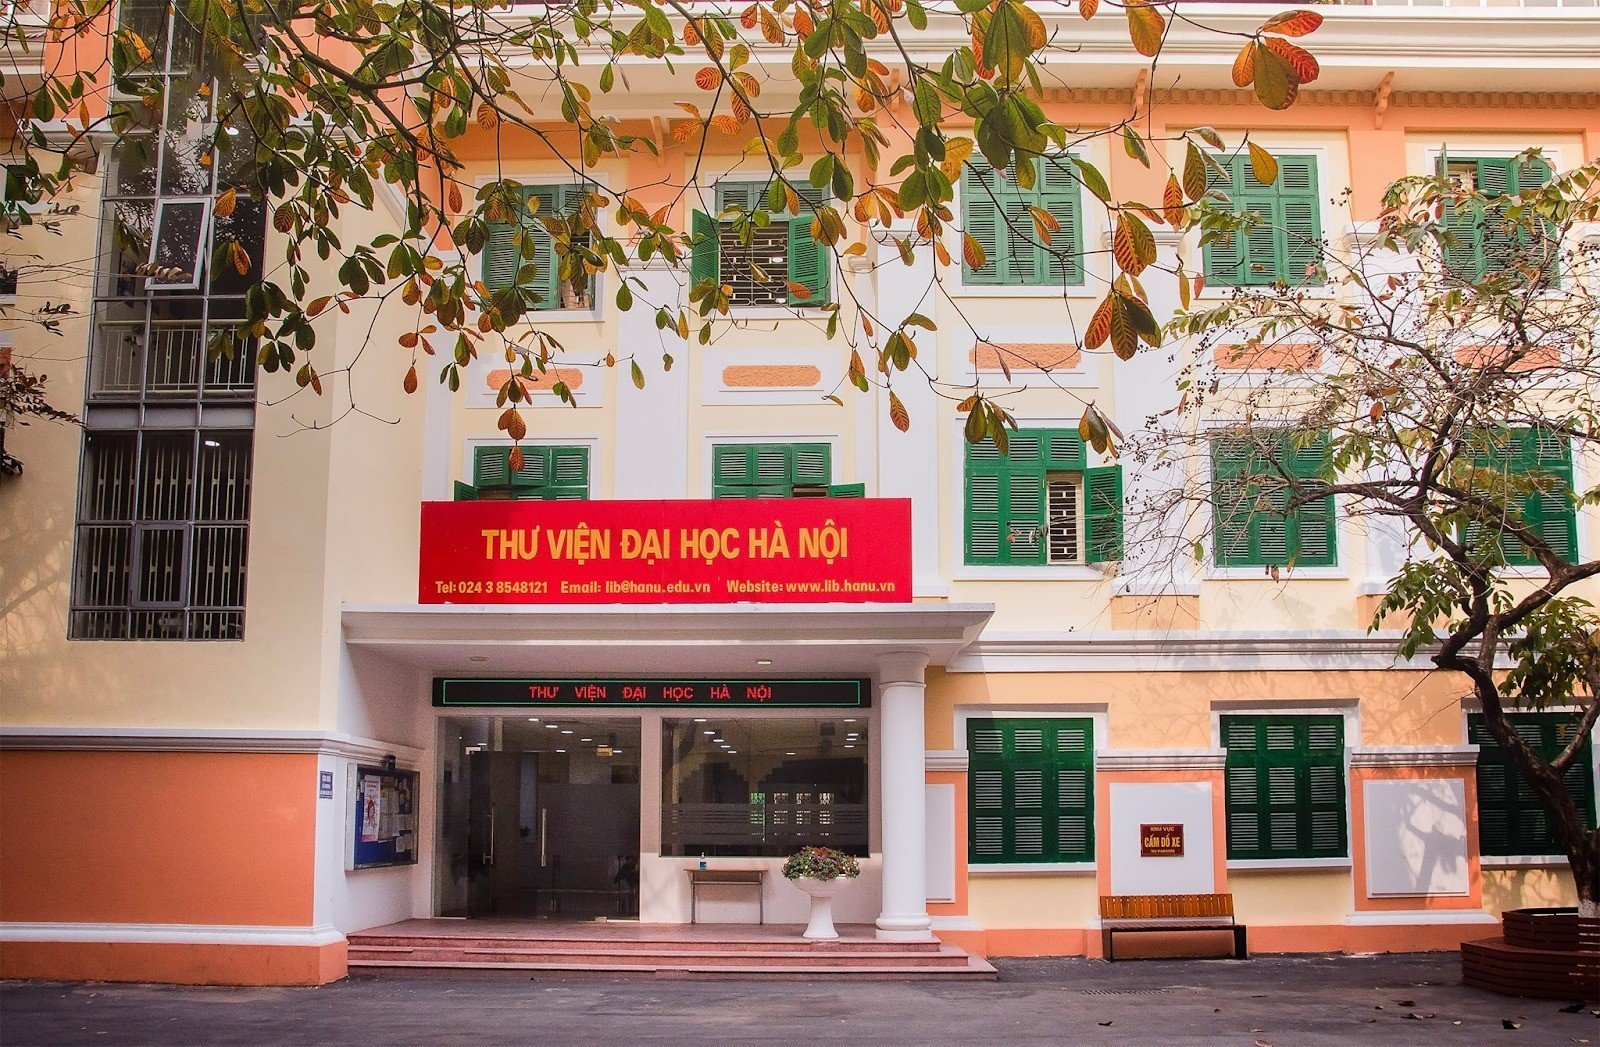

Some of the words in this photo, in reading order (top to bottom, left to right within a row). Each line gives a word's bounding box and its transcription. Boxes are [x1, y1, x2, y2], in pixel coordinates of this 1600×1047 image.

[481, 525, 540, 560] THƯ
[546, 521, 610, 565] VIỆN
[620, 528, 670, 565] ĐẠI
[680, 528, 740, 565] HỌC
[749, 520, 790, 559] HÀ
[799, 519, 848, 565] NỘI
[435, 580, 456, 594] Tel:
[458, 580, 482, 594] 024
[485, 580, 494, 594] 3
[496, 580, 548, 594] 8548121
[560, 580, 601, 594] Email:
[605, 580, 711, 594] lib@hanu.edu.vn
[727, 579, 783, 593] Website:
[786, 579, 896, 593] www.lib.hanu.vn
[529, 686, 559, 699] THƯ
[574, 684, 606, 701] VIỆN
[622, 686, 647, 701] ĐẠI
[662, 686, 693, 701] HỌC
[710, 684, 731, 699] HÀ
[746, 684, 772, 702] NỘI
[1171, 836, 1181, 848] XE
